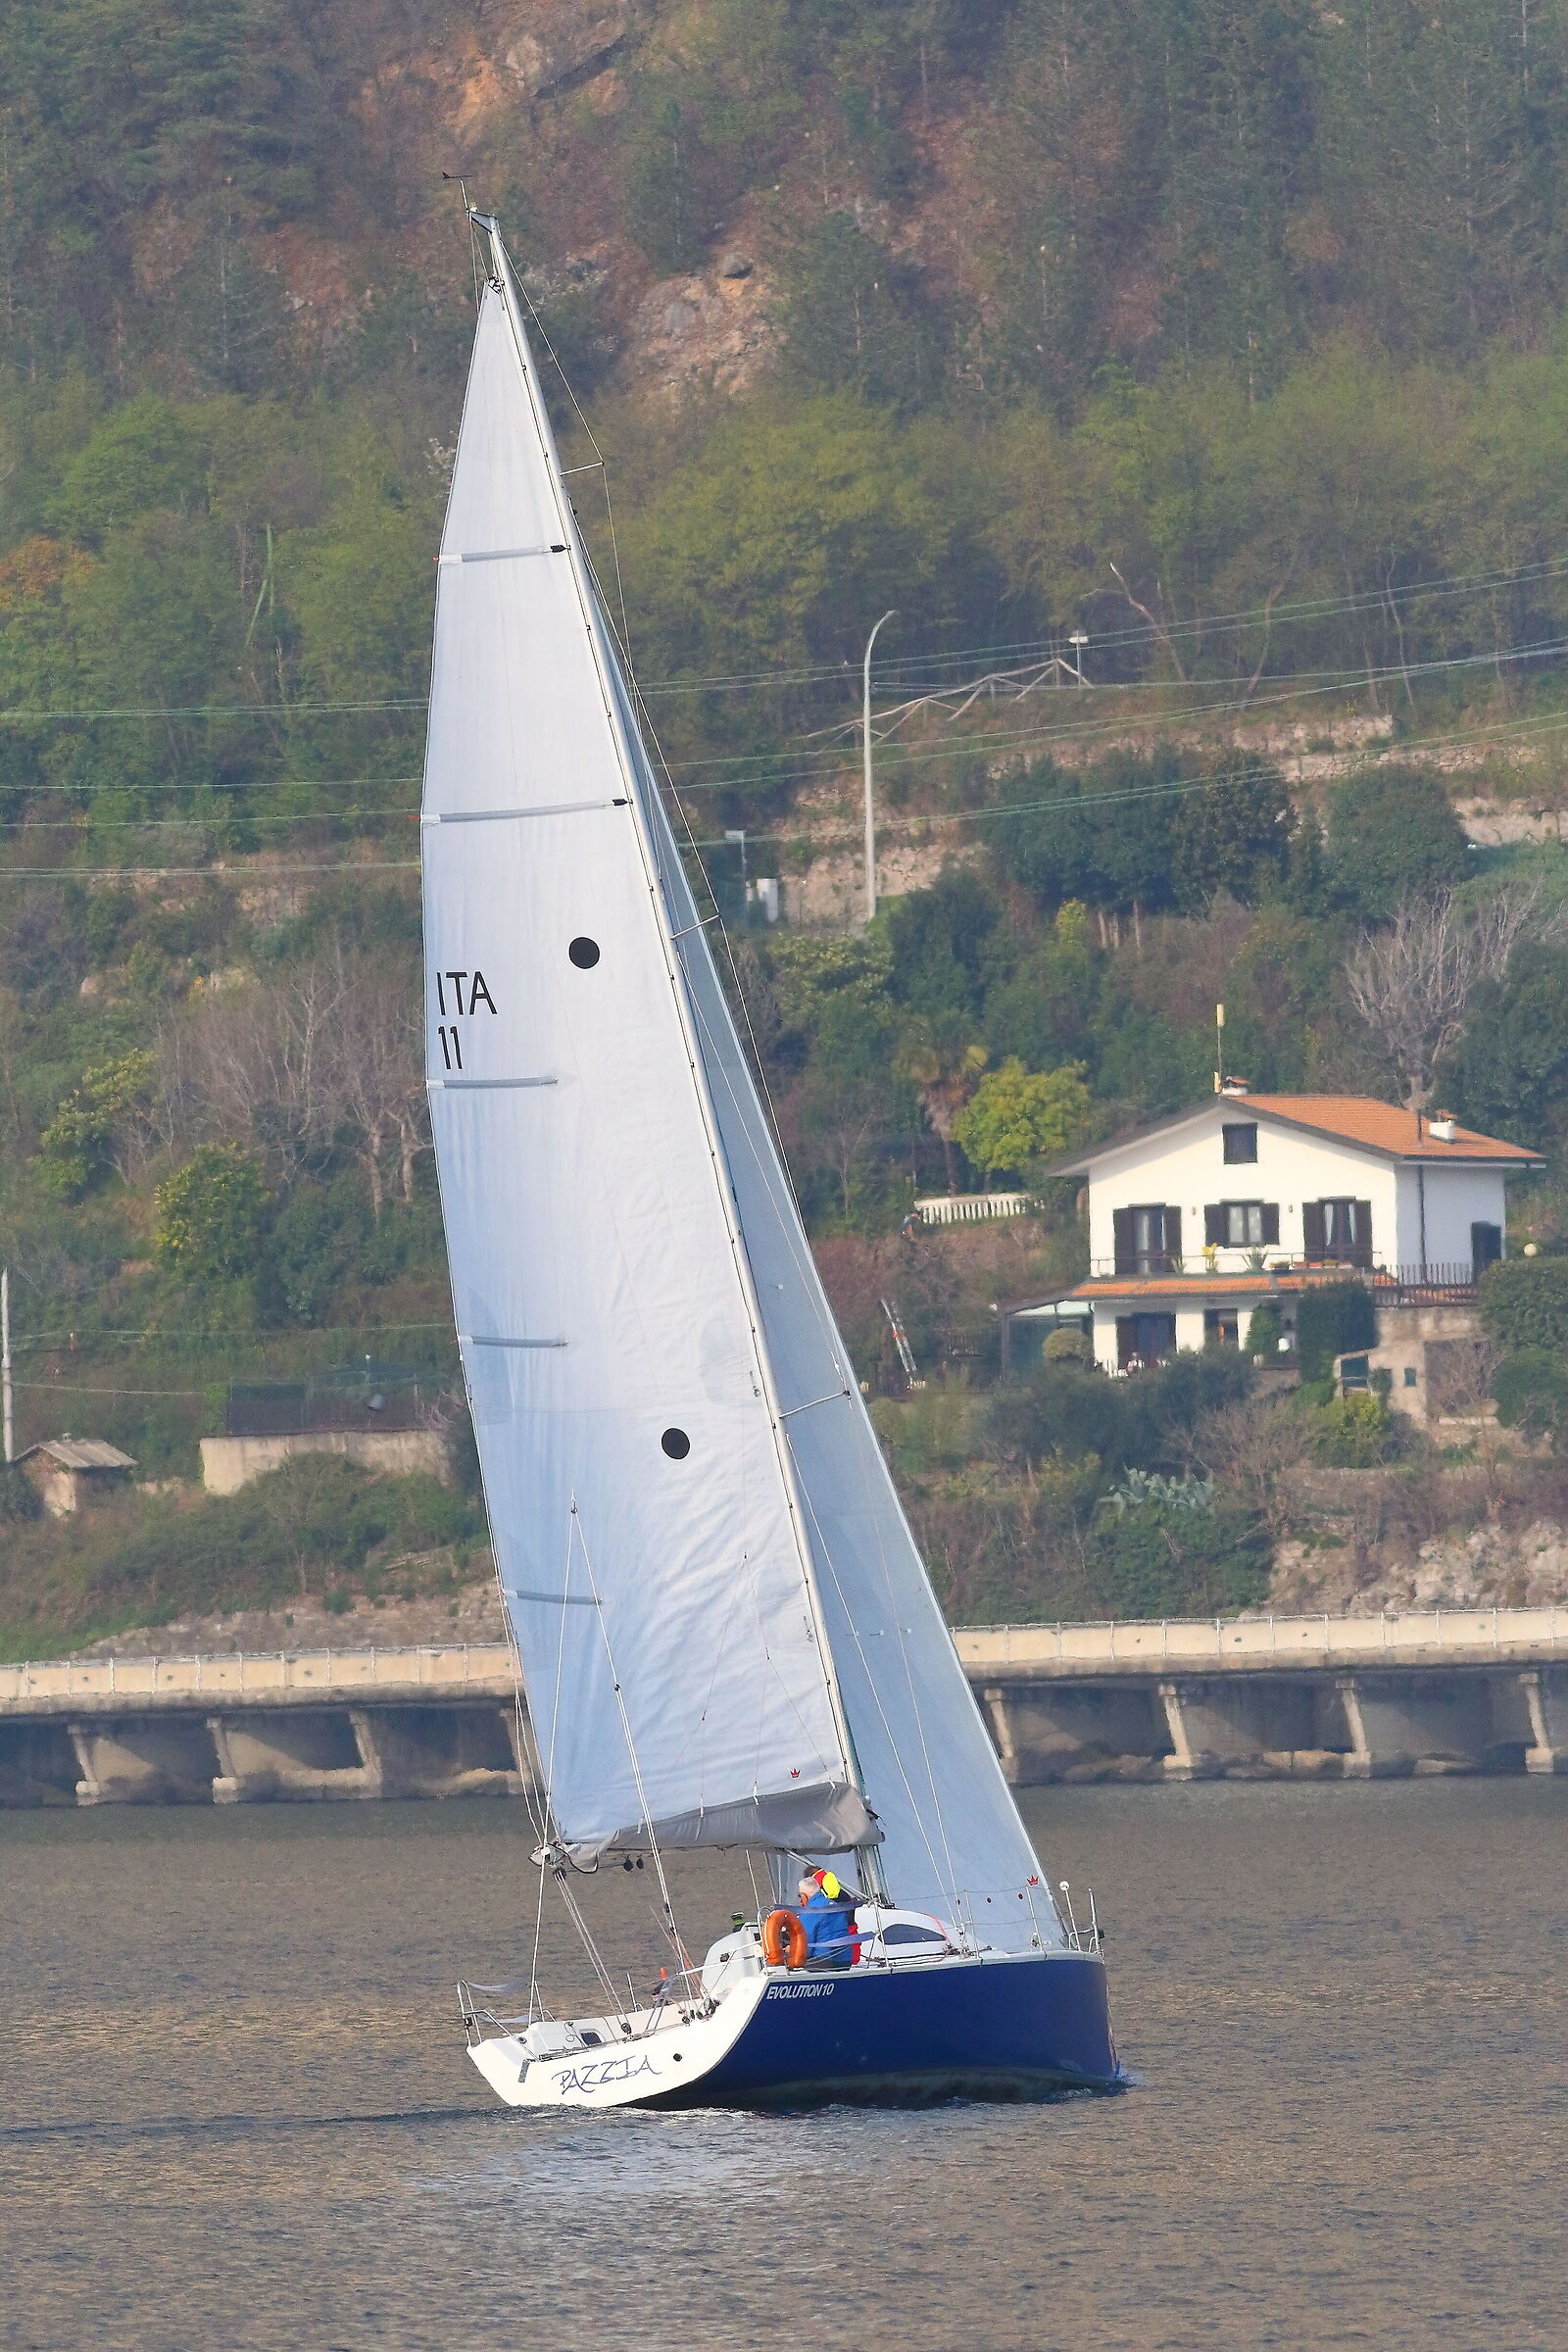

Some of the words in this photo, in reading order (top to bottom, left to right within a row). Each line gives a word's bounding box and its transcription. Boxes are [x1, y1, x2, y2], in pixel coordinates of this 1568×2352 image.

[436, 971, 498, 1015] ITA
[438, 1025, 463, 1069] 11
[766, 1984, 823, 1999] EVOLUTION
[822, 1983, 835, 1996] 10
[551, 2054, 662, 2095] PAZZIA
